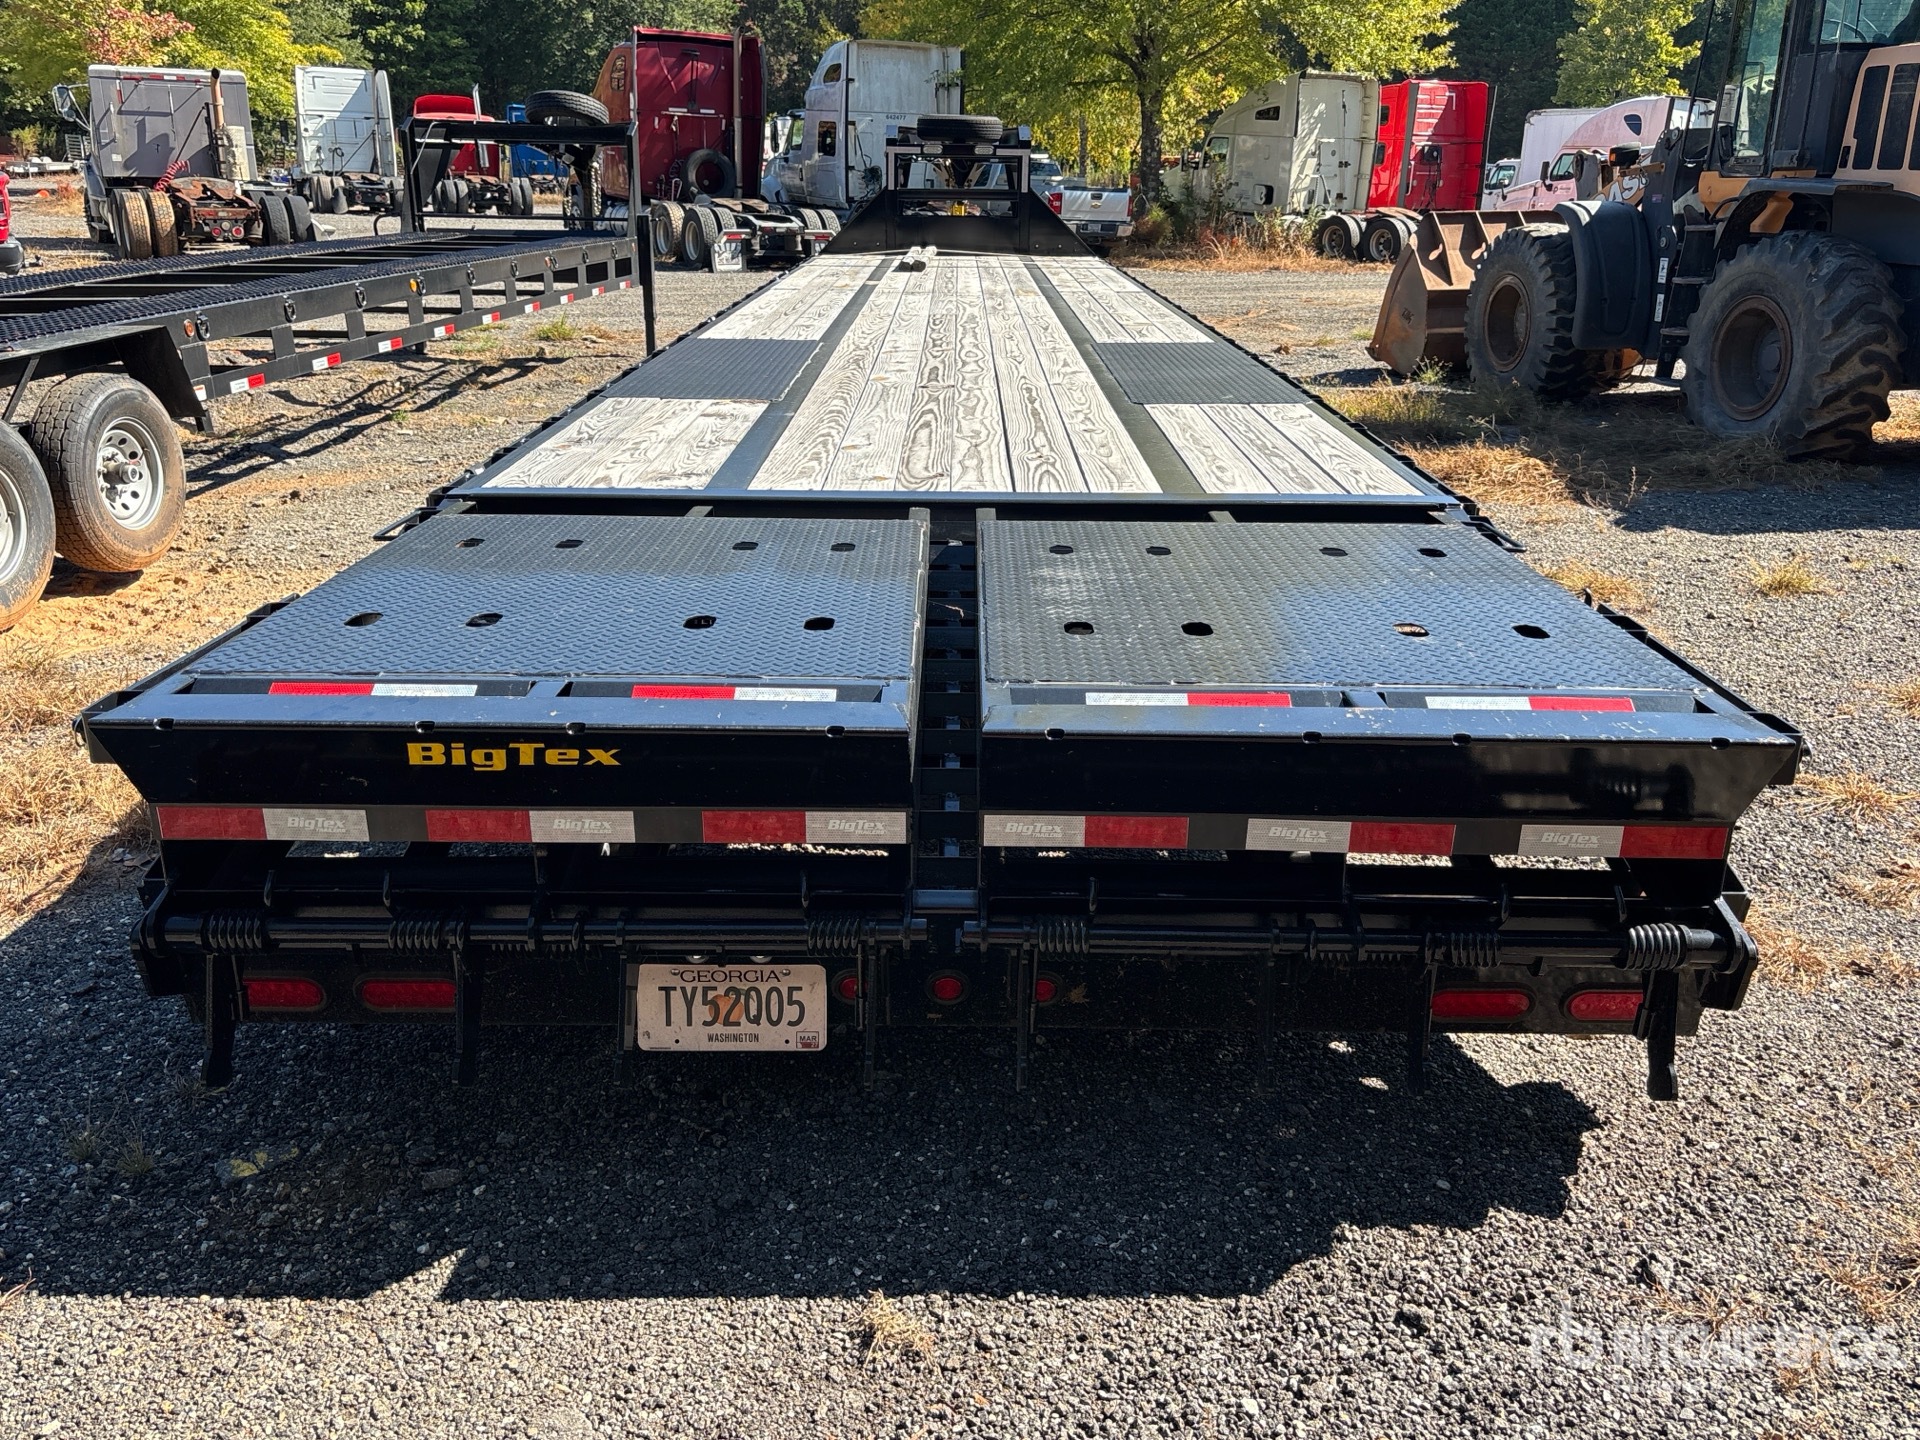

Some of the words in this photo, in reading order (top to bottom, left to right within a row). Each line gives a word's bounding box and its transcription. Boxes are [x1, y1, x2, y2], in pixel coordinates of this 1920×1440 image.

[406, 742, 622, 771] BigTex
[286, 816, 346, 831] BigTex
[552, 818, 612, 831] BigTex
[827, 819, 886, 833] BigTex
[1004, 822, 1064, 836] BigTex
[1268, 826, 1329, 840] BigTex
[1540, 832, 1600, 846] BigTex
[680, 969, 782, 983] GEORGIA
[657, 986, 806, 1027] TY52Q05
[707, 1032, 760, 1043] WASHINGTON
